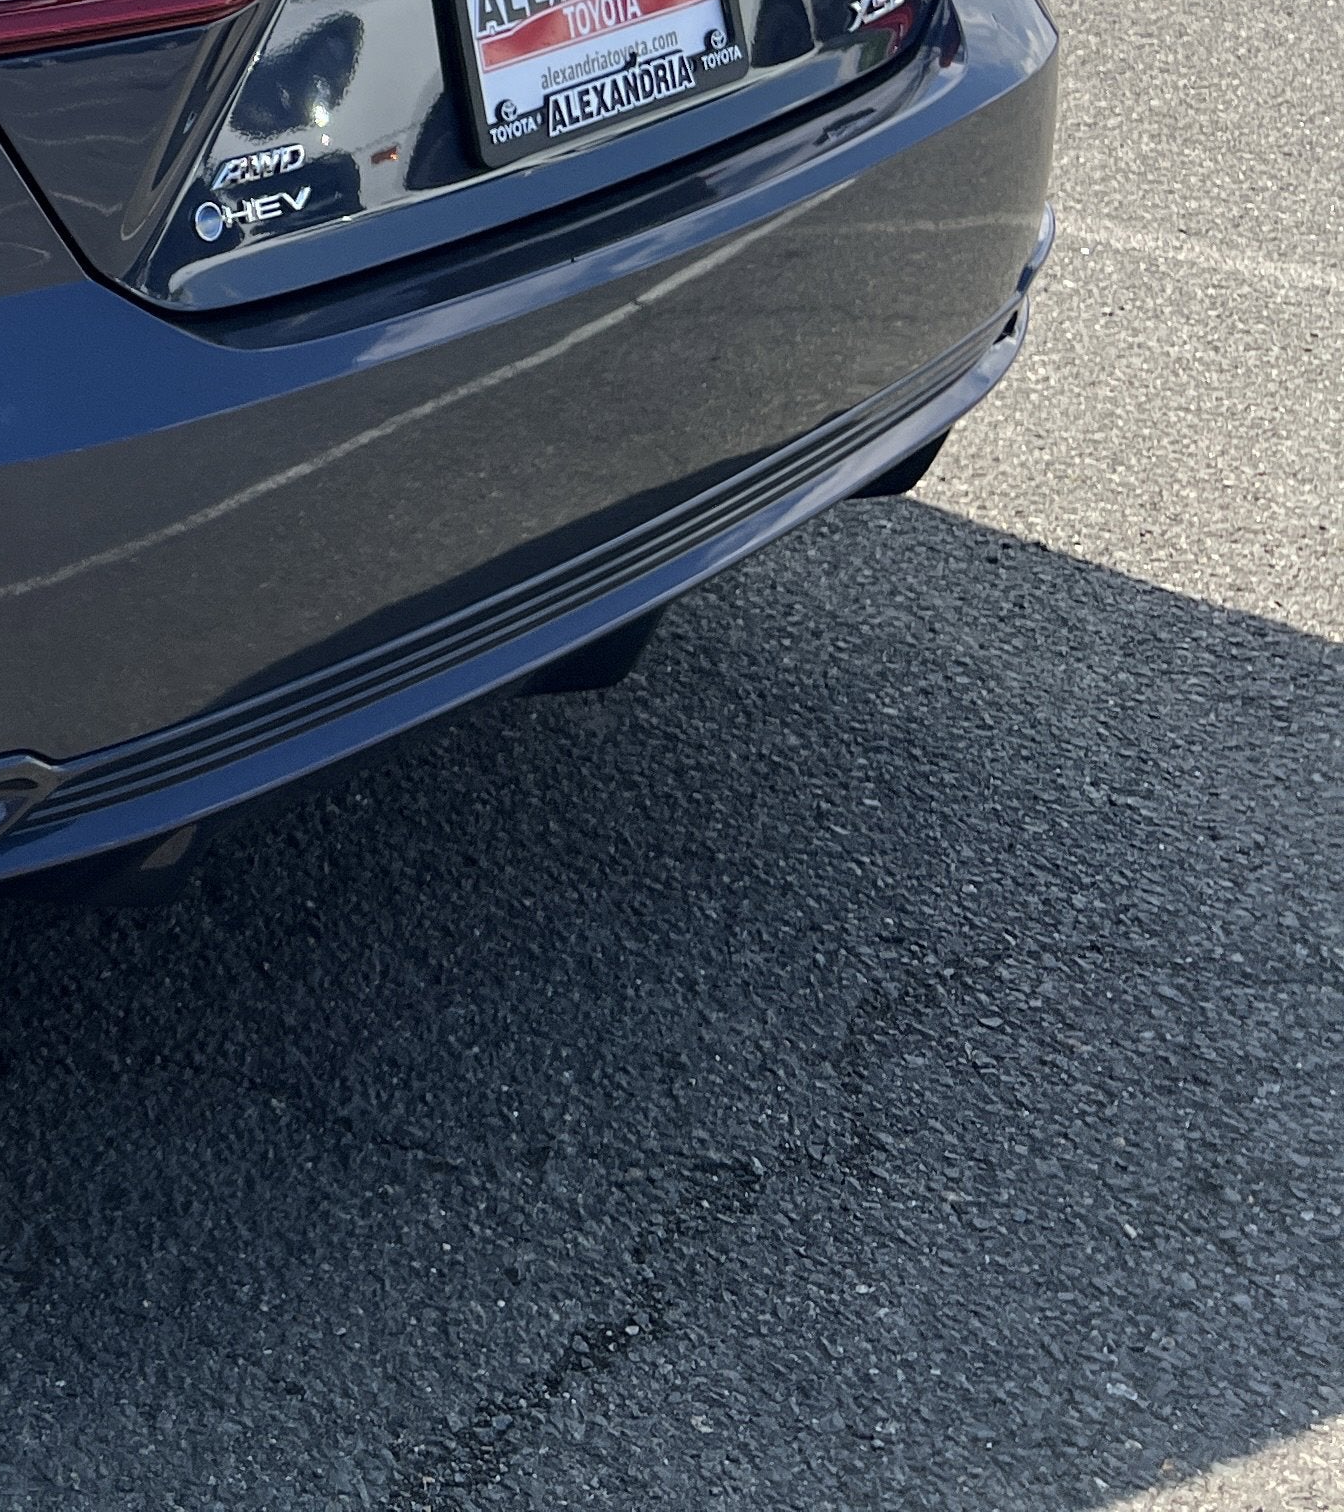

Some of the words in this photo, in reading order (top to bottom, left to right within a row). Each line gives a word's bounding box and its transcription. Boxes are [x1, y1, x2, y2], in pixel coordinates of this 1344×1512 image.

[541, 30, 679, 90] alexandriatoyota.com
[489, 117, 538, 145] TOYOTA
[549, 52, 696, 136] ALEXANDRIA
[701, 44, 743, 71] TOYOTA
[211, 143, 306, 191] AWD
